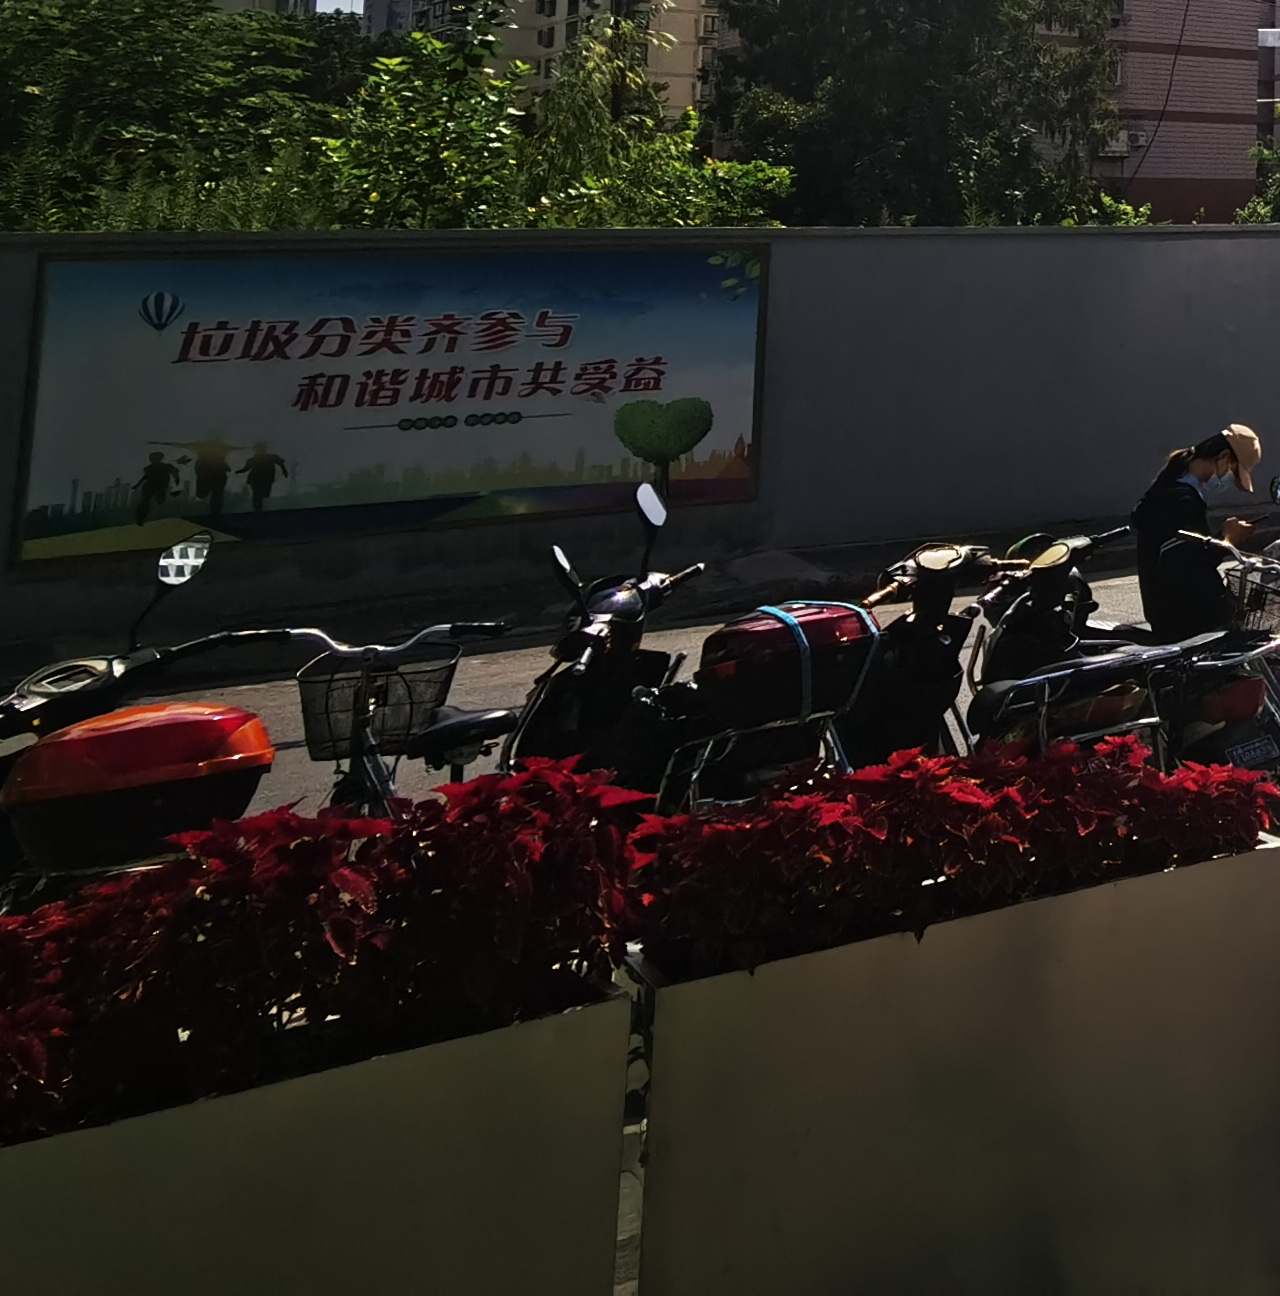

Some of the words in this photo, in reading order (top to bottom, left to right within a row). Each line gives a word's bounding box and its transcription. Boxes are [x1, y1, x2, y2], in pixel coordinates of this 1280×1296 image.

[172, 308, 581, 365] 垃圾分类齐参与
[291, 356, 670, 412] 和谐城市共受益
